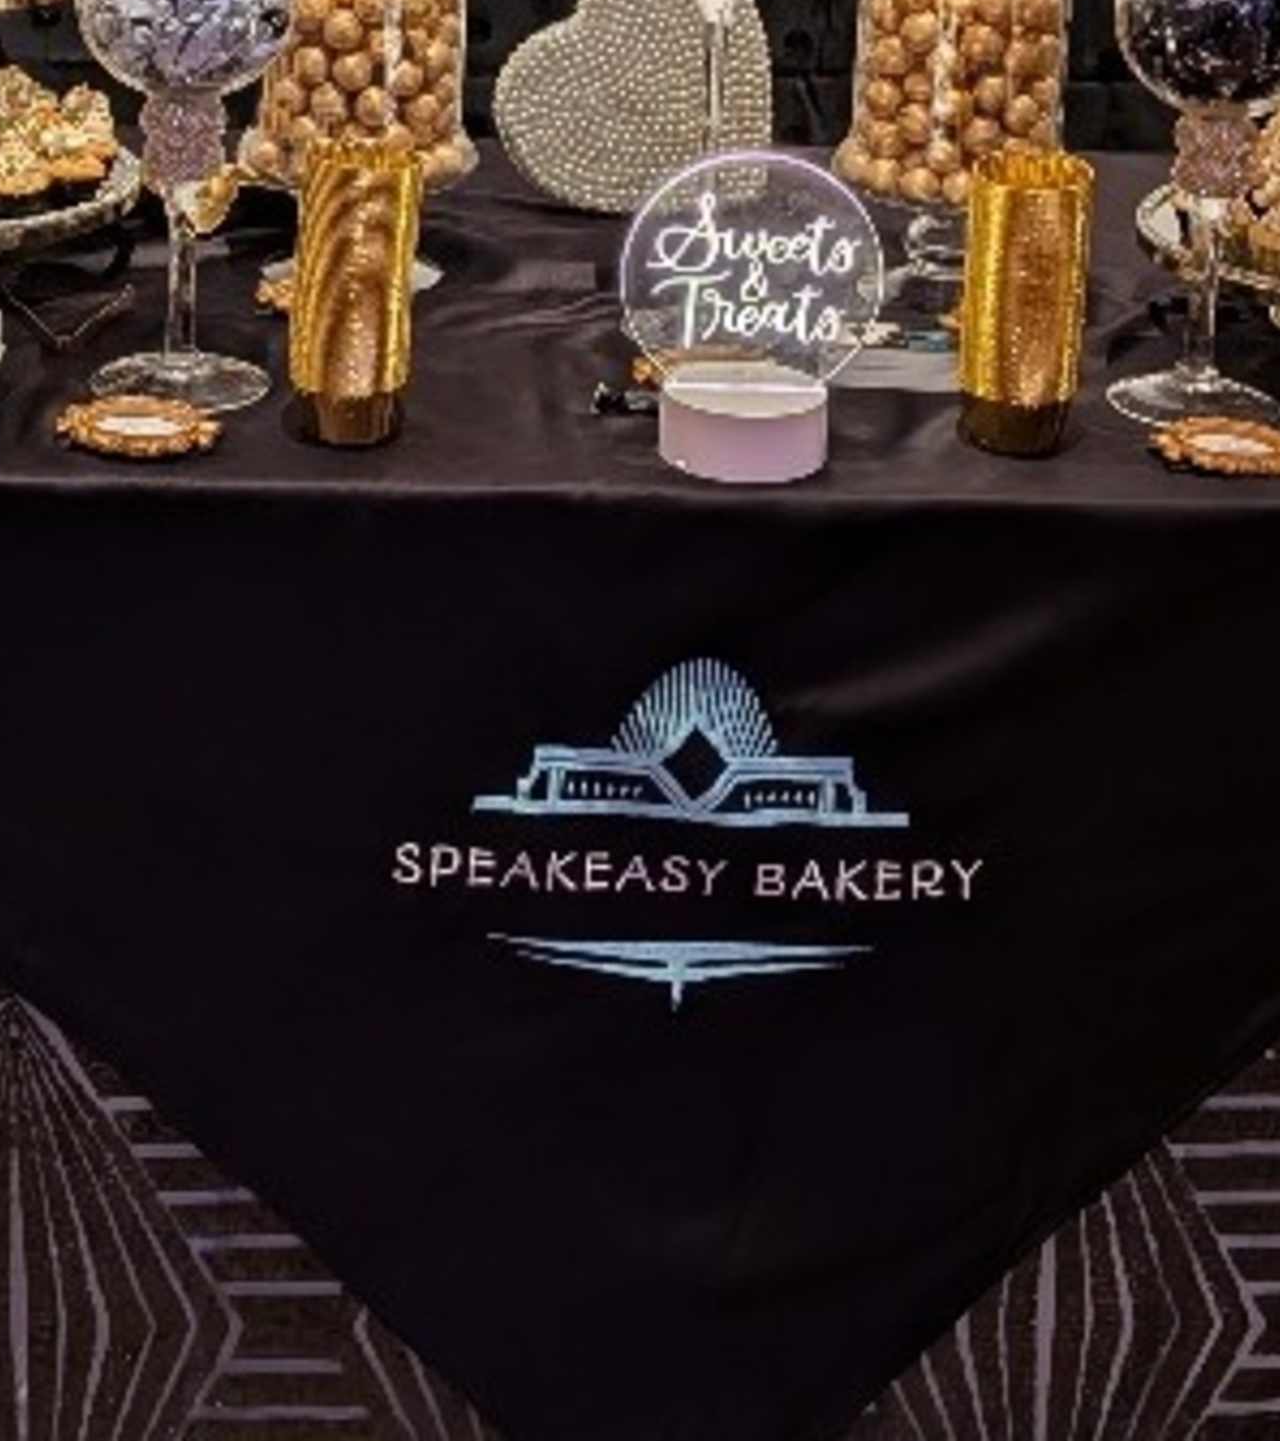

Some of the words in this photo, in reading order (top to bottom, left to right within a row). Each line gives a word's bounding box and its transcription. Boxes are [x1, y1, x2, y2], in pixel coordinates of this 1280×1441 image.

[646, 190, 862, 277] Sweets
[650, 269, 846, 350] Treats
[740, 259, 768, 302] &
[392, 843, 727, 897] SPEAKEASY
[754, 859, 984, 902] BAKERY
